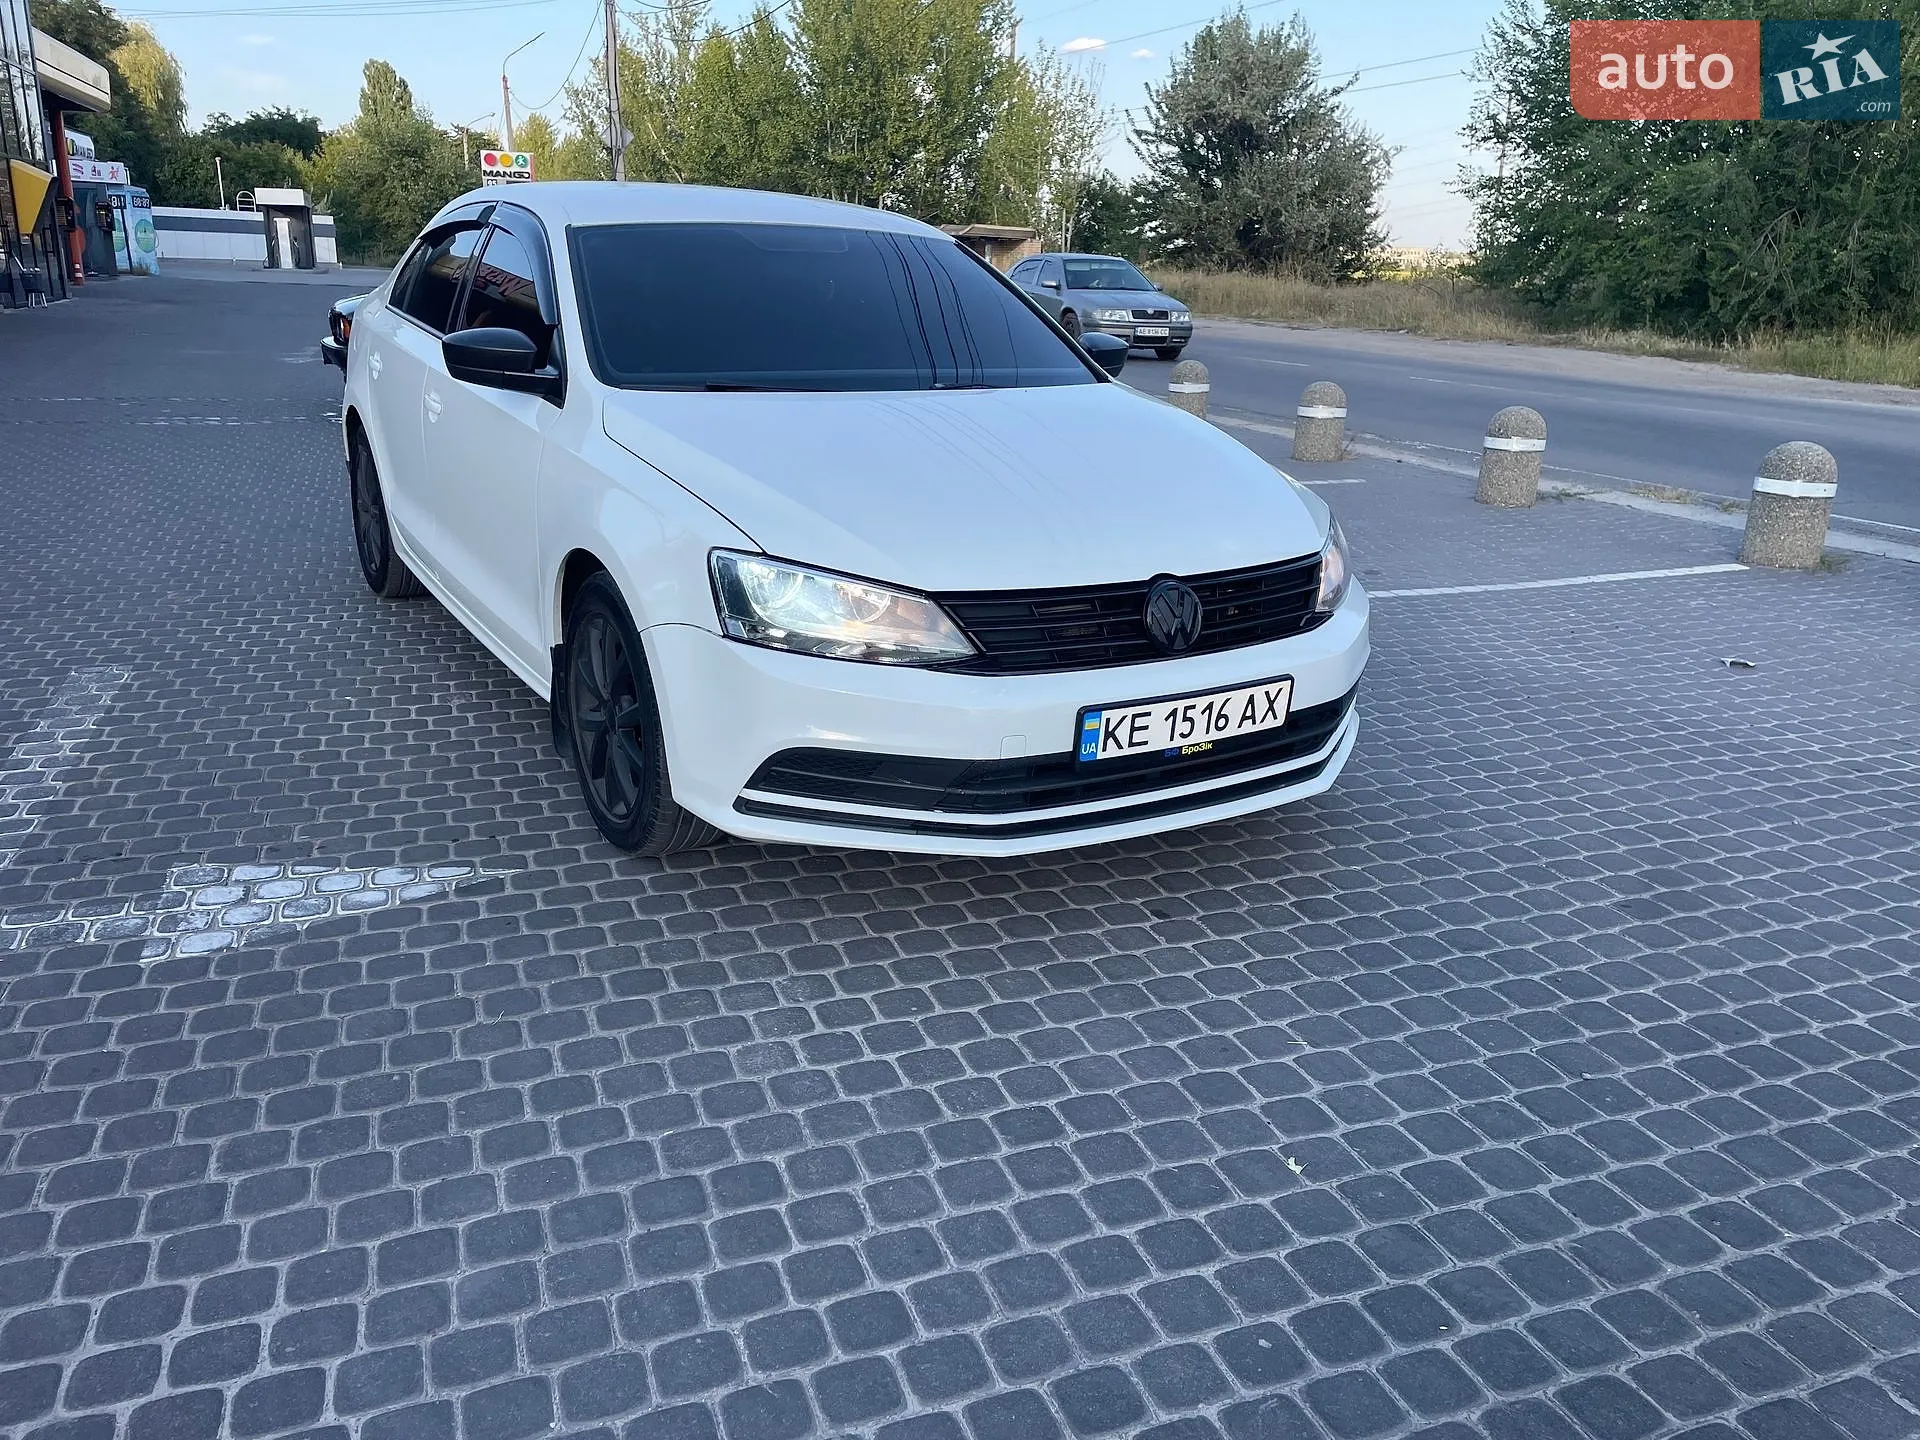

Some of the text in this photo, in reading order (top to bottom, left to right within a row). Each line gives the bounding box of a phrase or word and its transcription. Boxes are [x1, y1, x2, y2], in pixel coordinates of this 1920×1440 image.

[483, 170, 531, 179] MANGO
[1101, 687, 1284, 752] KE 1516 AX
[1081, 742, 1097, 755] UA
